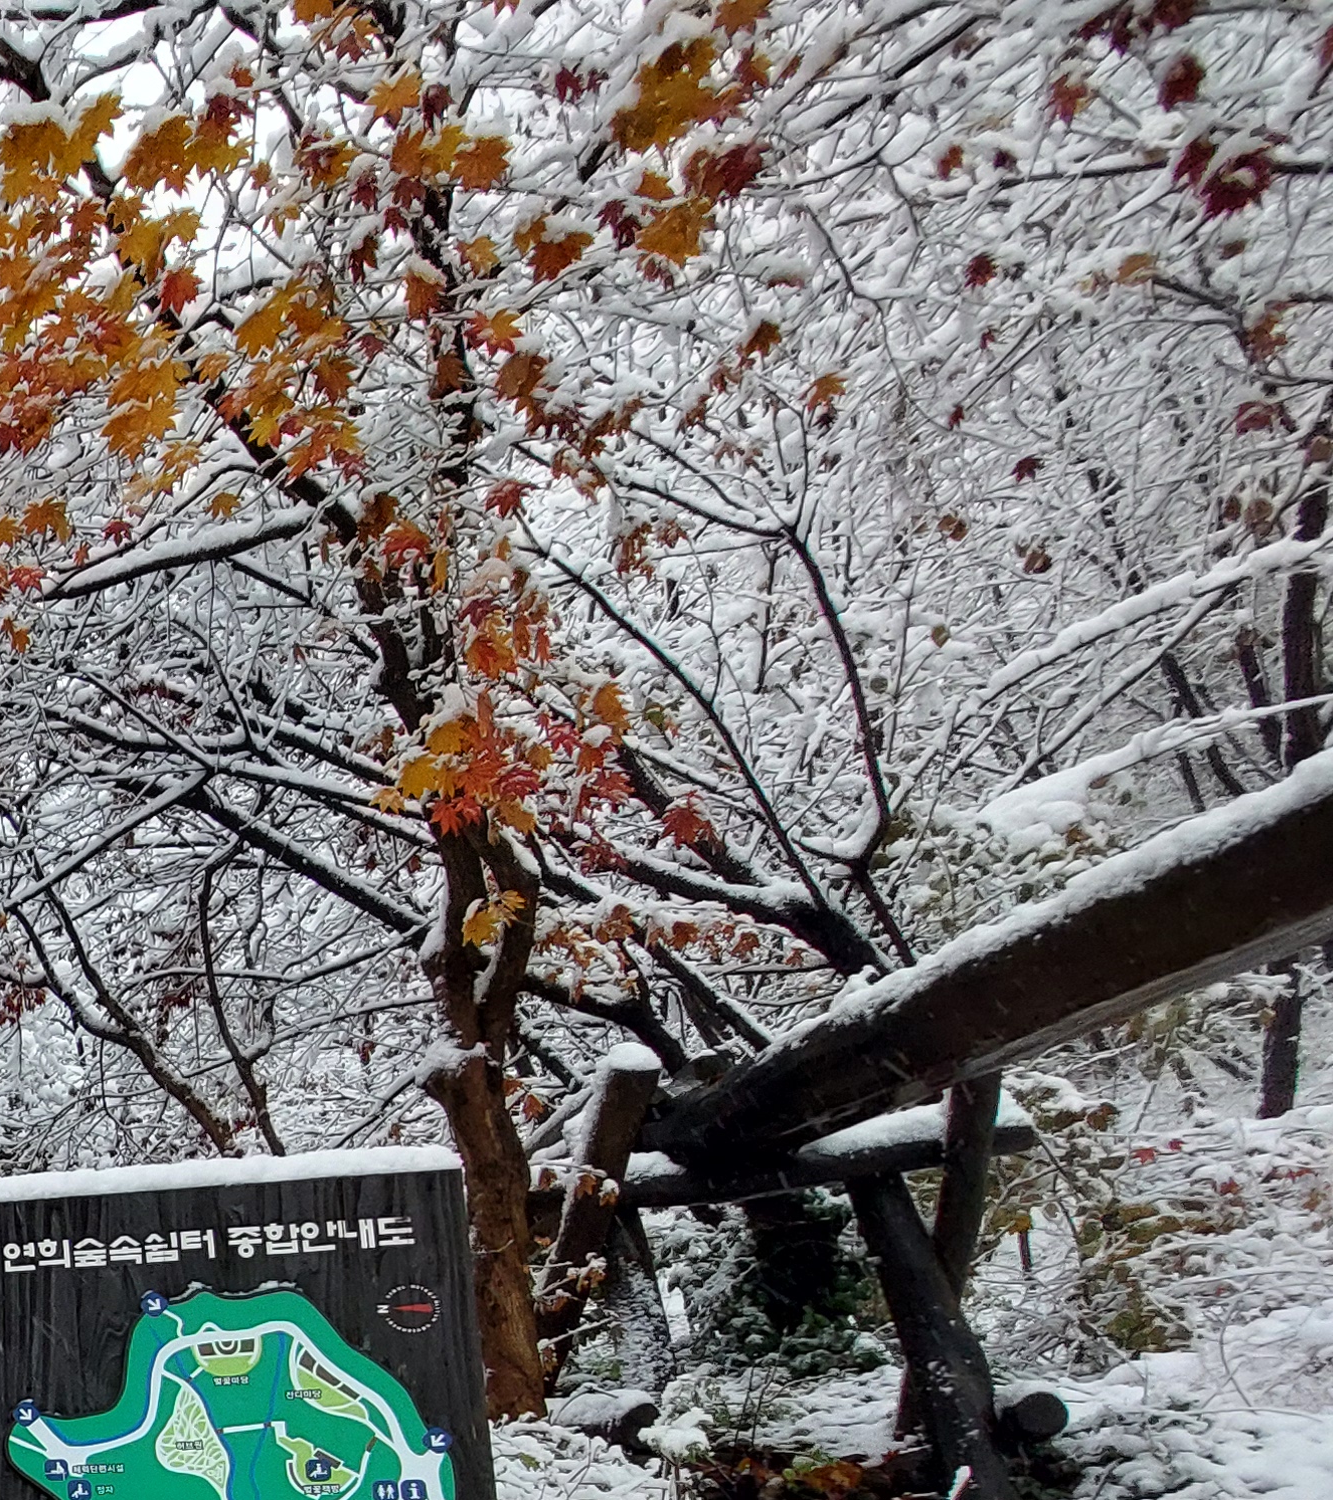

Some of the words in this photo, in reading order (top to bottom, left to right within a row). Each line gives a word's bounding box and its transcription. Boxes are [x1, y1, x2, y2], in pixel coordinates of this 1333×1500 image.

[3, 1229, 216, 1272] 연희숲속쉼터
[228, 1216, 415, 1258] 종합안내도
[286, 1389, 321, 1399] 잔디마당
[97, 1485, 114, 1495] 정자
